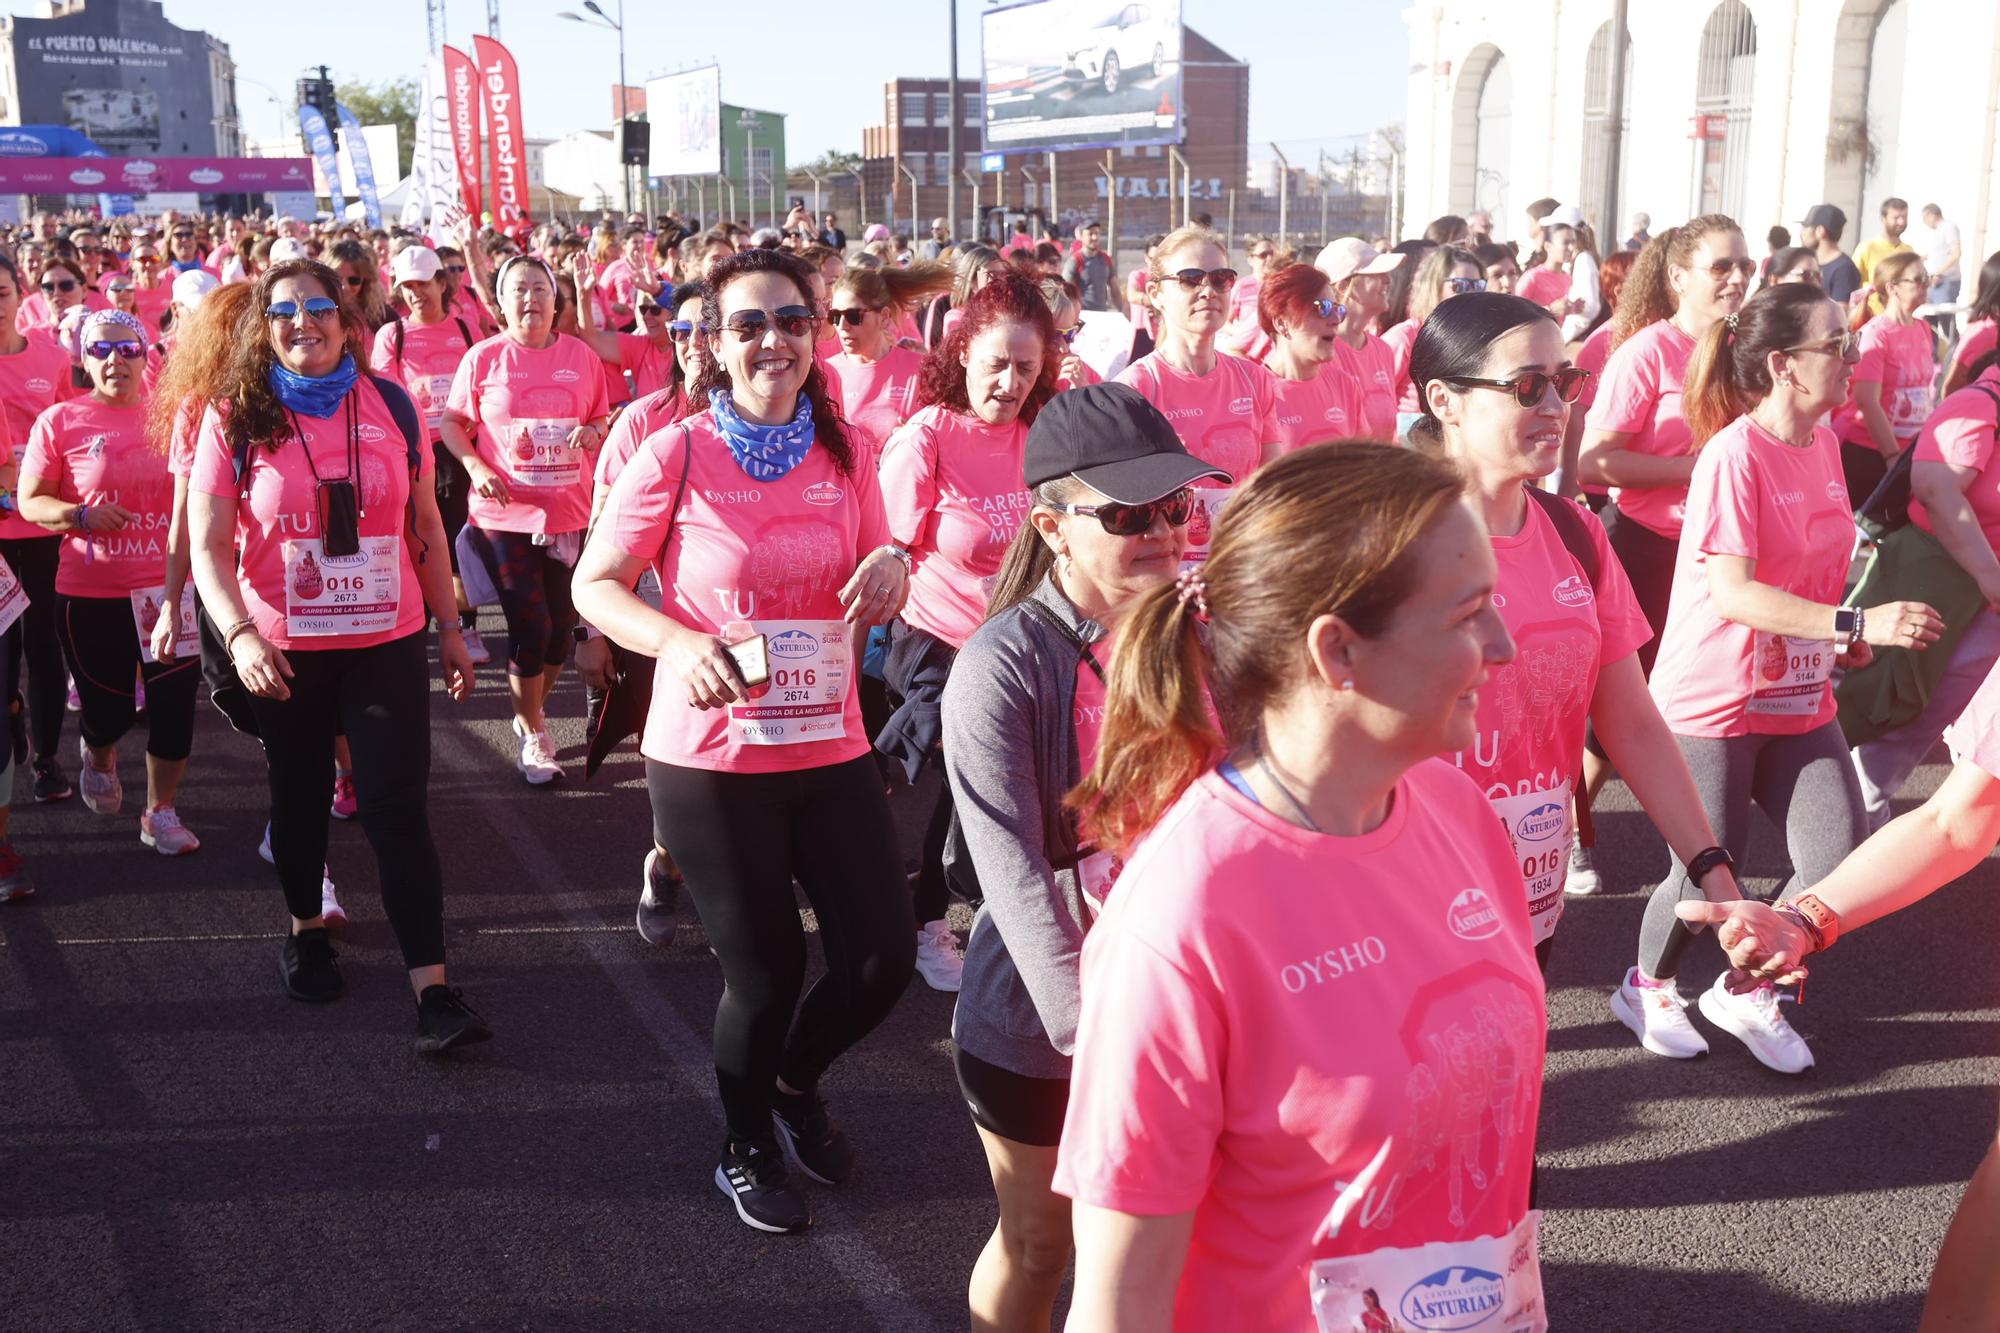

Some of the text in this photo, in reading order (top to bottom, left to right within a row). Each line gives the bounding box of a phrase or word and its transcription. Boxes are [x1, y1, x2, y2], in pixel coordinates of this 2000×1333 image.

[28, 37, 43, 50] EL
[45, 35, 96, 52] PUERTO
[454, 65, 474, 167] Santander
[486, 60, 520, 222] Santander
[1163, 407, 1204, 421] OYSHO
[706, 489, 761, 504] OYSHO
[968, 491, 1033, 512] CARRER
[274, 511, 312, 533] TU
[988, 511, 1014, 527] DE
[96, 536, 160, 556] SUMA
[326, 576, 364, 591] 016
[334, 593, 358, 602] 2673
[713, 588, 754, 619] TU
[301, 607, 332, 615] CARRERA
[345, 605, 354, 613] LA
[354, 604, 375, 612] MUJER
[299, 620, 334, 630] OYSHO
[360, 617, 391, 626] Santander
[771, 640, 816, 653] ASTURIANA
[1790, 652, 1821, 670] 016
[775, 669, 816, 686] 016
[1795, 671, 1815, 682] 5144
[784, 690, 809, 701] 2674
[1765, 688, 1793, 697] CARRERA
[1803, 685, 1810, 693] LA
[744, 708, 782, 717] CARRERA
[784, 708, 793, 716] DE
[795, 707, 804, 715] LA
[804, 706, 824, 714] MUJER
[743, 725, 784, 736] OYSHO
[1521, 815, 1562, 836] ASTURIANA
[1523, 848, 1558, 877] 016
[1531, 876, 1552, 895] 1934
[1529, 901, 1547, 913] DE LA
[1280, 936, 1387, 993] OYSHO
[1328, 1172, 1400, 1239] TU
